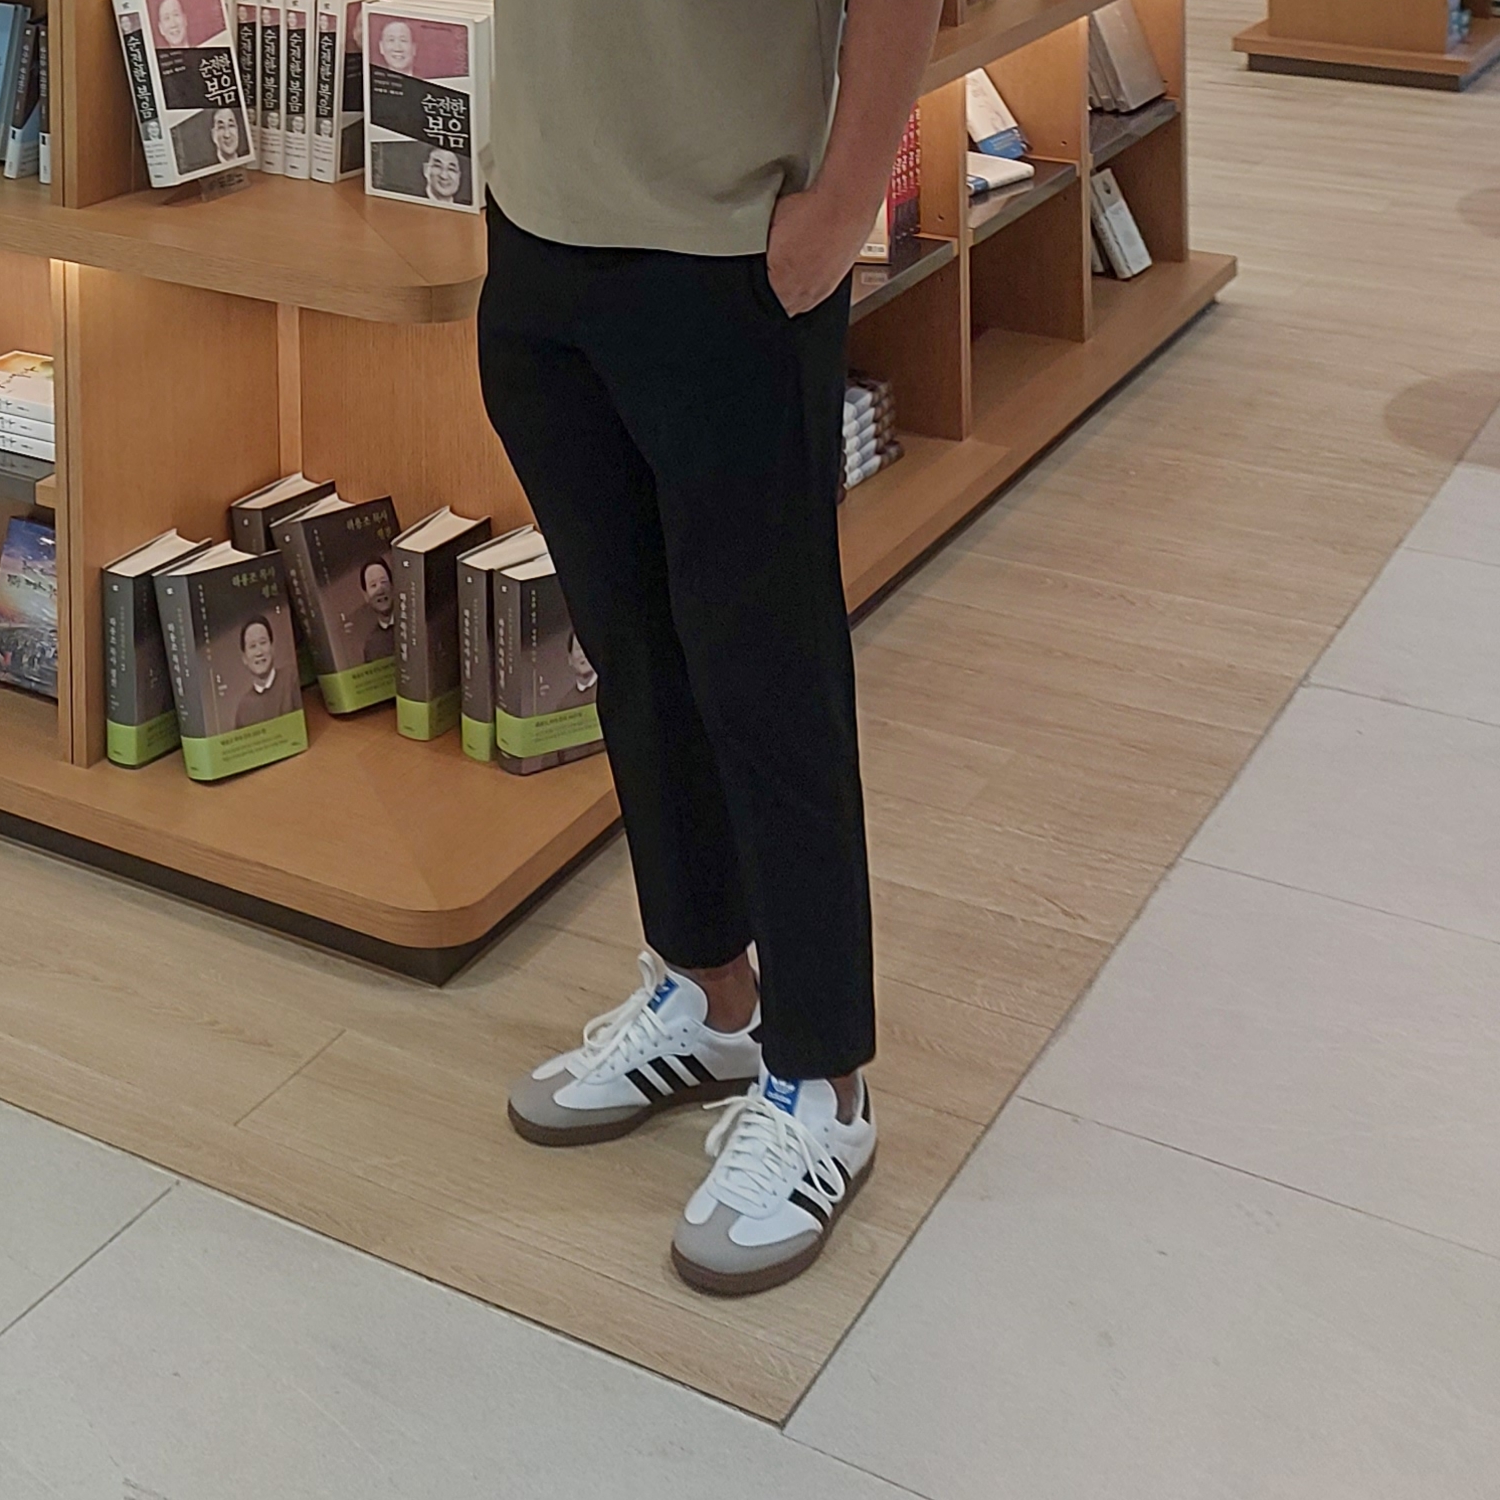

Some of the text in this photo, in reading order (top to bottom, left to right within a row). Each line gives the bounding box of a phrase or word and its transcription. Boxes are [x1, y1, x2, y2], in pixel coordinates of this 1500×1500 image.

[198, 53, 232, 78] 순전한
[137, 84, 154, 119] 복음
[204, 74, 237, 106] 복음
[420, 93, 467, 119] 순전한
[422, 115, 469, 148] 복음
